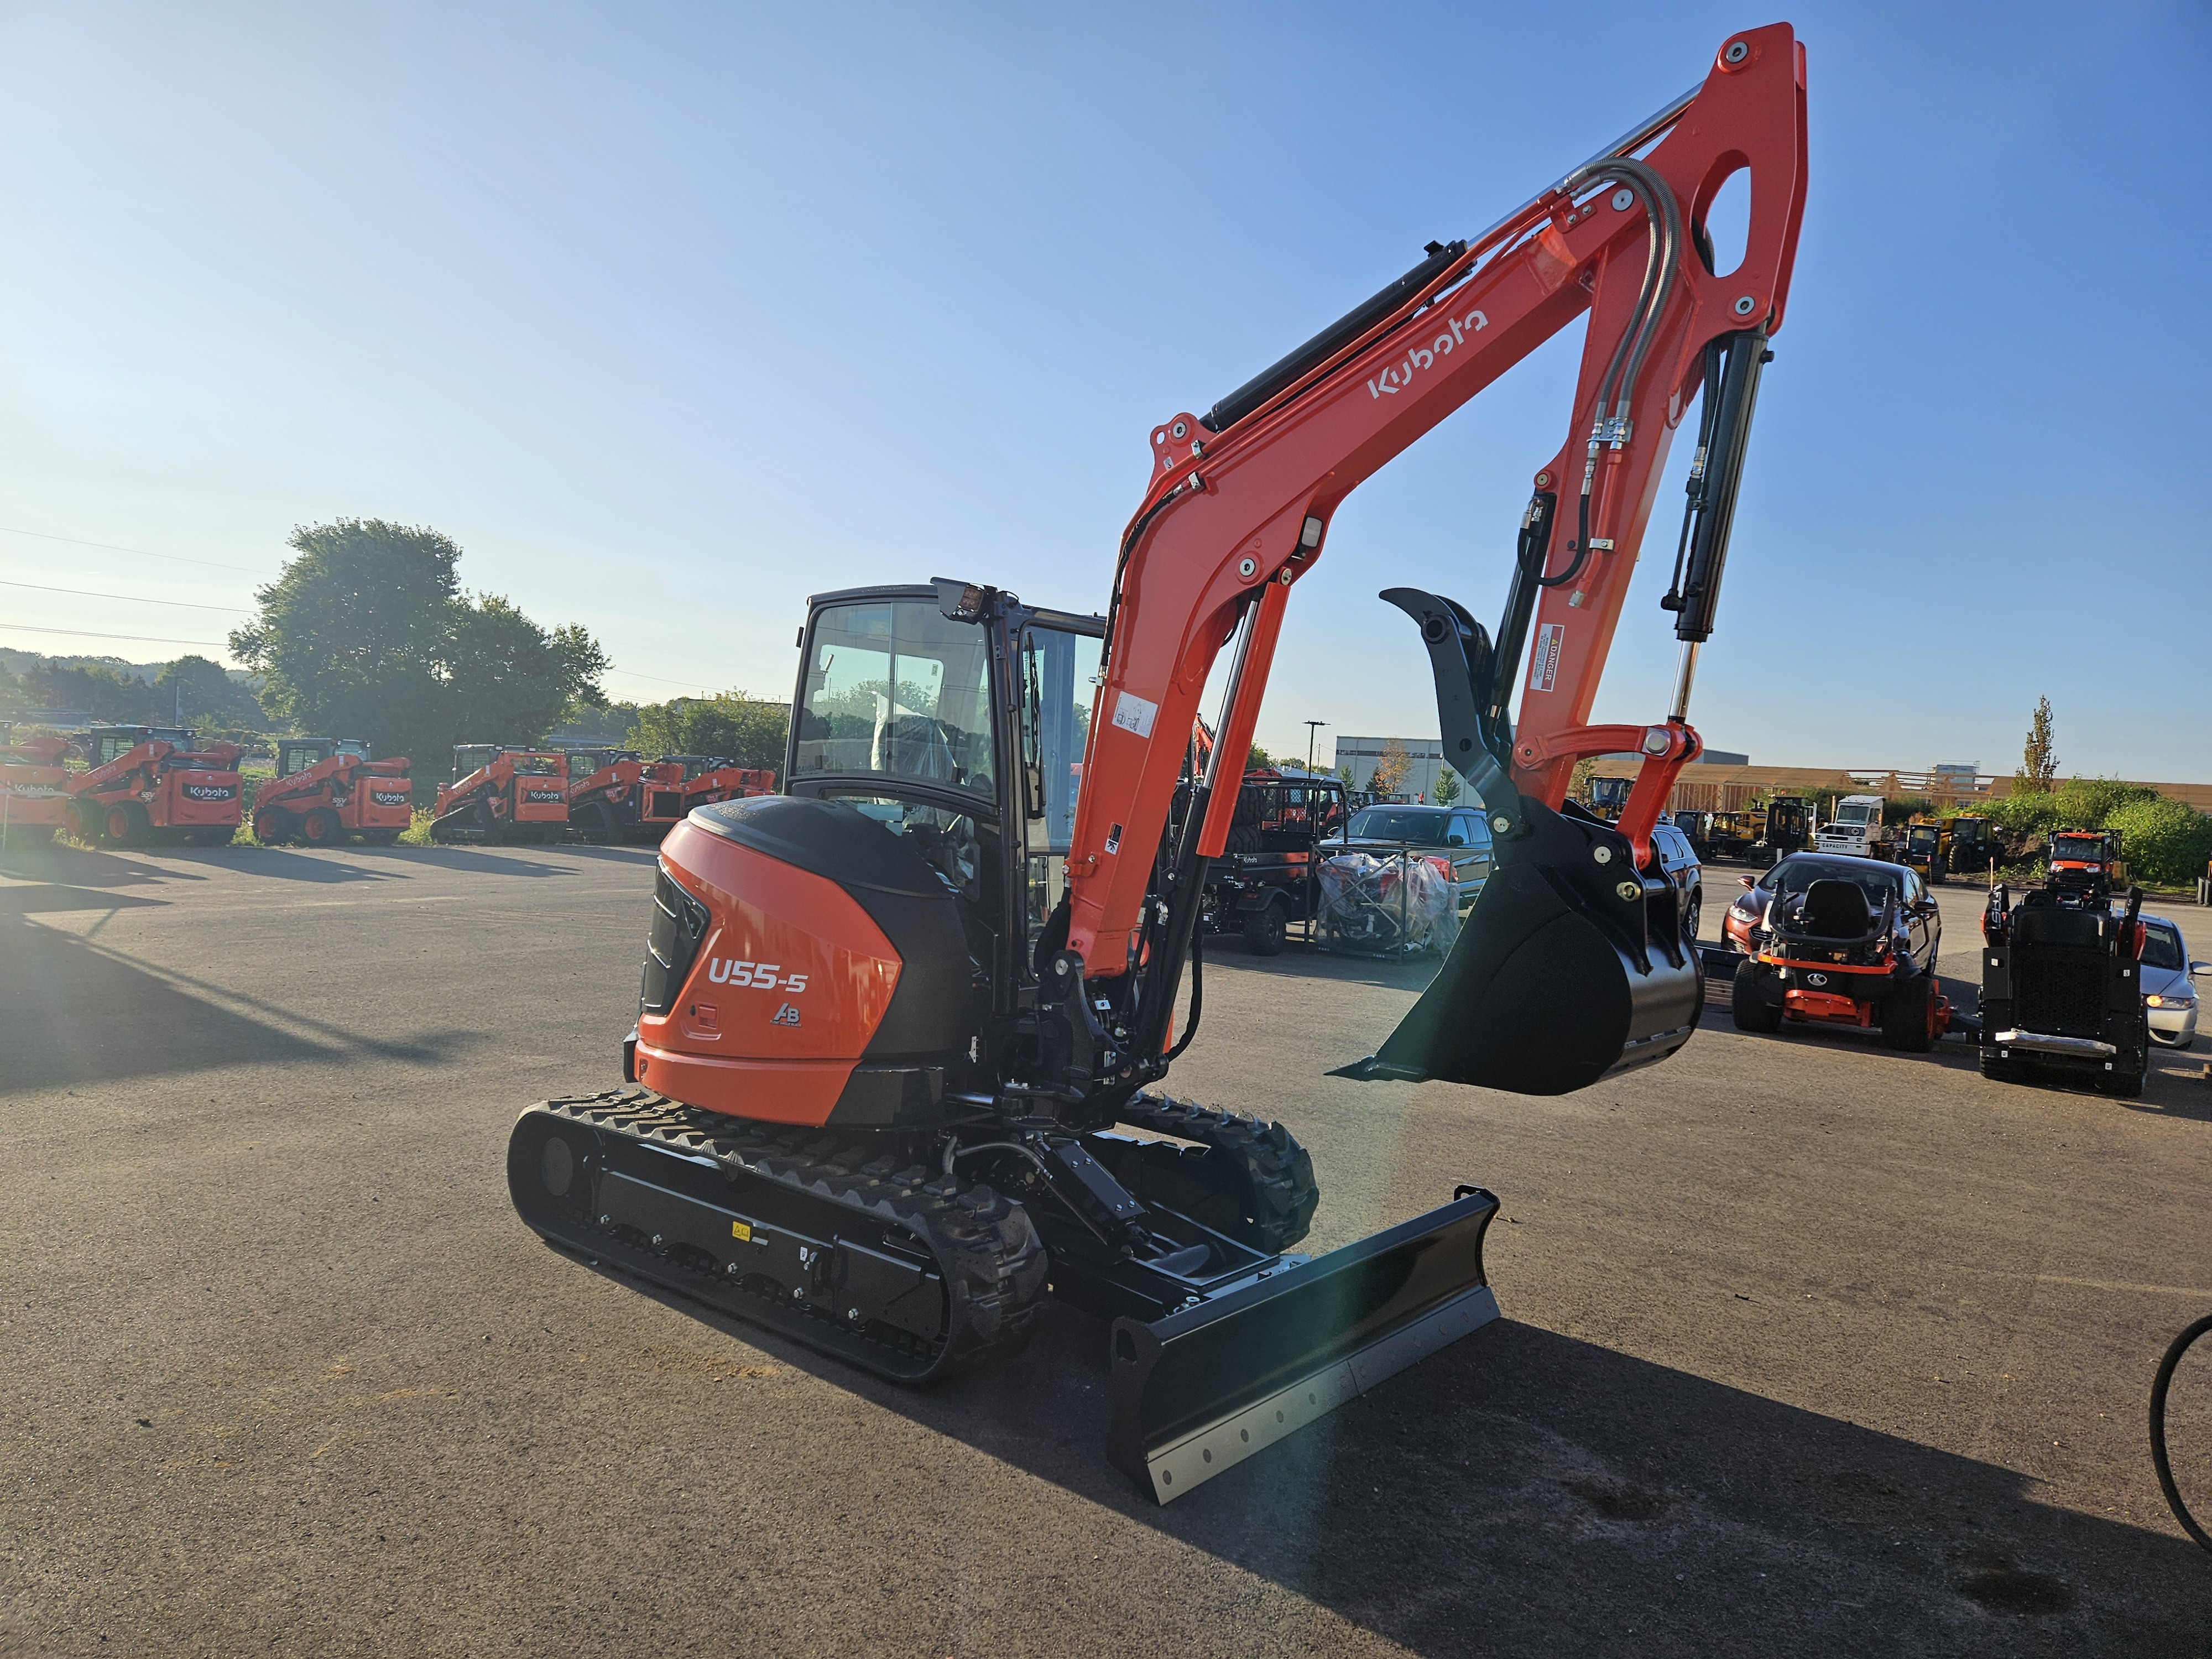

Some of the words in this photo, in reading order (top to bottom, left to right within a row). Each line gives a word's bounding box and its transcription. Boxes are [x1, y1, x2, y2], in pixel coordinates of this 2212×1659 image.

[1367, 310, 1489, 399] Kubota
[1545, 645, 1557, 680] DANGER
[286, 772, 312, 786] Kubota
[14, 784, 54, 792] Kubota
[190, 787, 229, 796] Kubota
[376, 792, 404, 802] Kubota
[708, 957, 808, 993] U55-5
